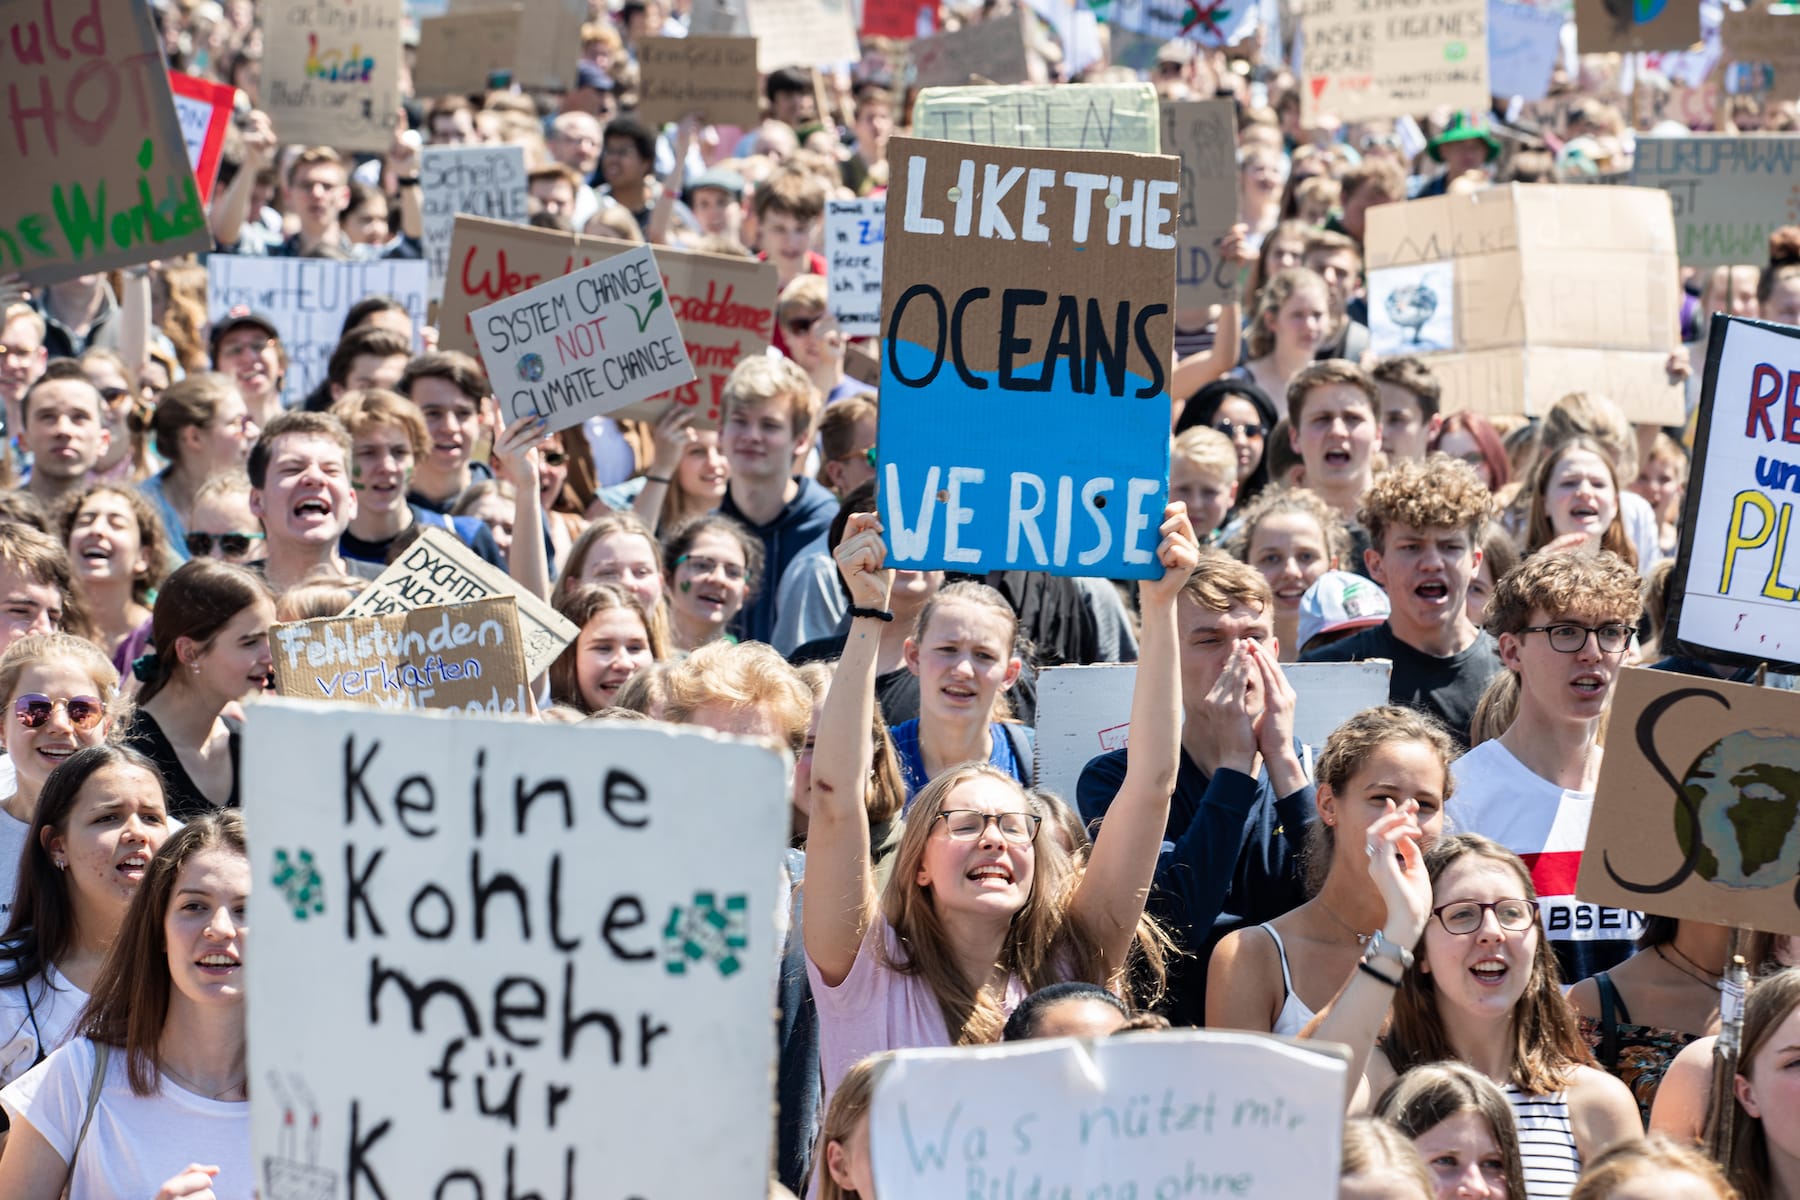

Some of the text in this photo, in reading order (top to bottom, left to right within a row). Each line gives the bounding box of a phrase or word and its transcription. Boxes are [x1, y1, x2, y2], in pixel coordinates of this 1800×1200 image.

[0, 0, 106, 66] uld
[904, 155, 1056, 242] LIKE
[1064, 171, 1179, 249] THE
[461, 245, 542, 301] Wer
[487, 293, 572, 353] SYSTEM
[576, 258, 658, 315] CHANGE
[511, 337, 683, 419] CLIMATE CHANGE
[554, 315, 608, 366] NOT
[887, 283, 1168, 399] OCEANS
[885, 463, 1161, 567] WE RISE
[276, 612, 505, 671] Fehlstunden
[315, 655, 483, 698] verkraften
[343, 732, 651, 839] Keine
[344, 843, 656, 962] Kohle
[367, 954, 670, 1067] mehr
[429, 1035, 571, 1129] für
[346, 1099, 648, 1200] Kohl
[899, 1088, 1306, 1174] Was nützt mir
